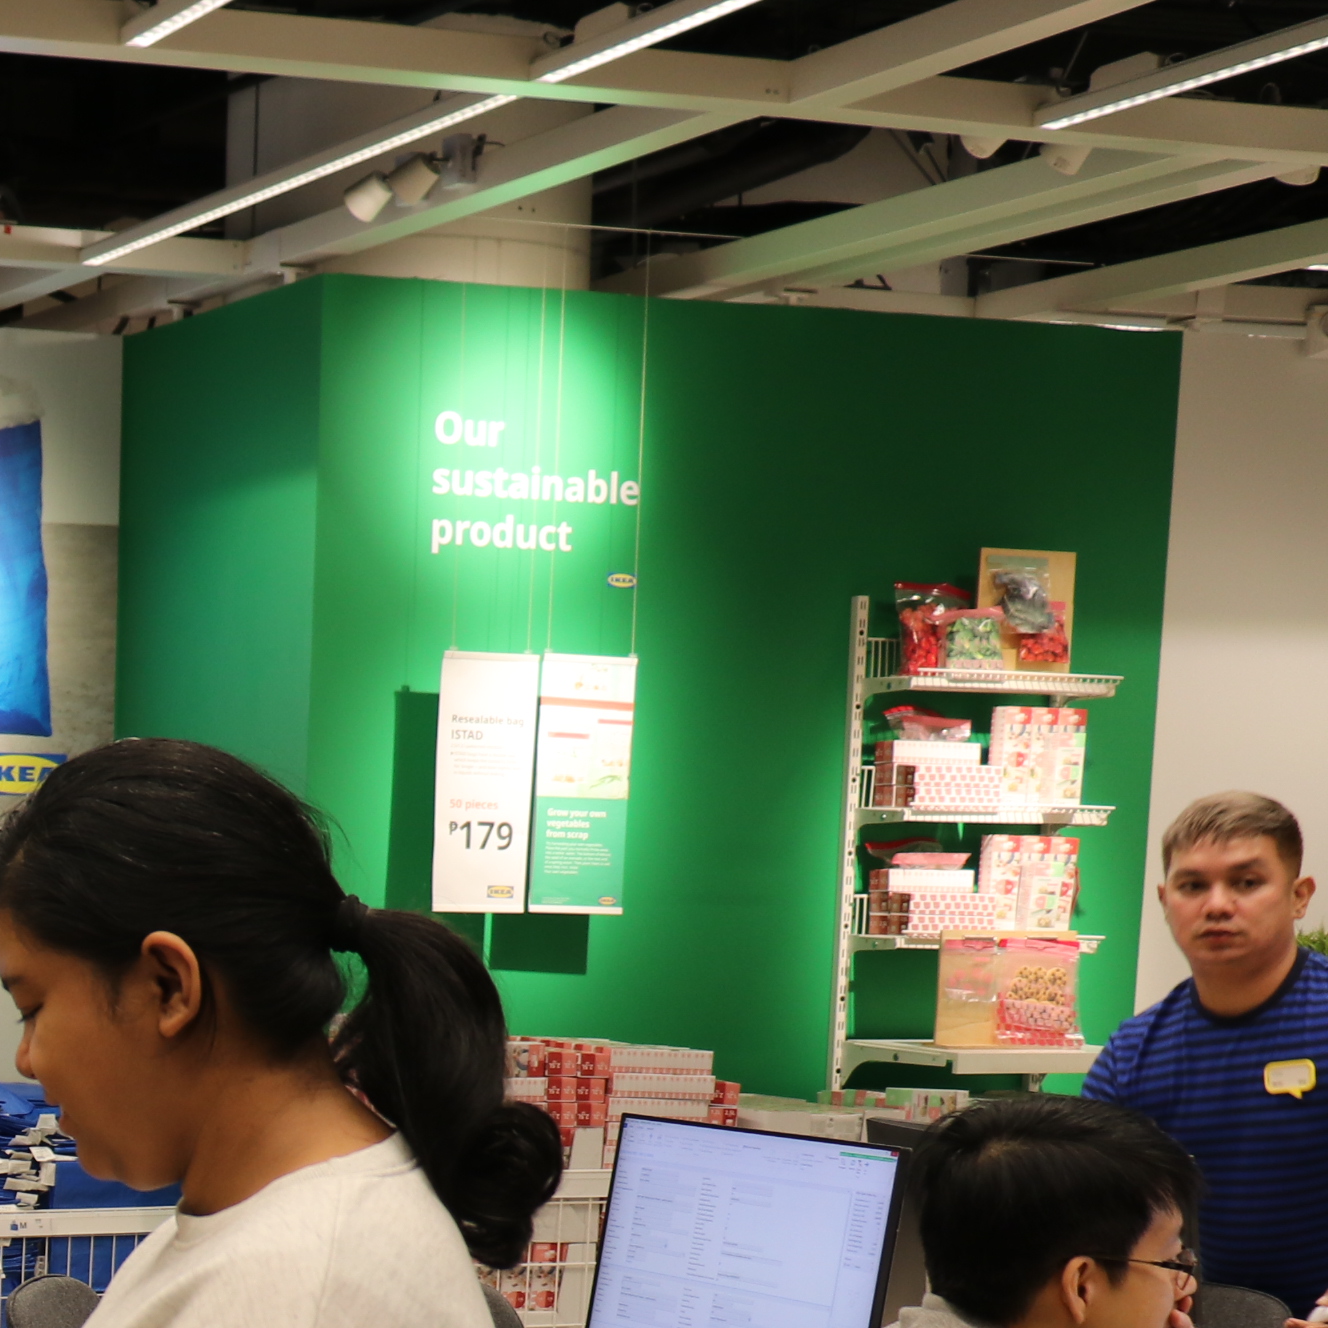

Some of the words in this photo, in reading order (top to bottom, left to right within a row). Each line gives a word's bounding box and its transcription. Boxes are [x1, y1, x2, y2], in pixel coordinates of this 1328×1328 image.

[435, 411, 506, 448] Our
[432, 465, 640, 506] sustainable
[431, 514, 573, 554] product
[451, 714, 504, 725] Resealable
[506, 716, 524, 727] bag
[451, 729, 484, 740] ISTAD
[449, 799, 462, 809] 50
[464, 799, 499, 812] pieces
[547, 808, 569, 818] Grow
[569, 810, 589, 819] your
[546, 819, 591, 830] vegetables
[546, 829, 566, 838] from
[566, 831, 589, 841] scrap
[19, 1221, 28, 1230] M
